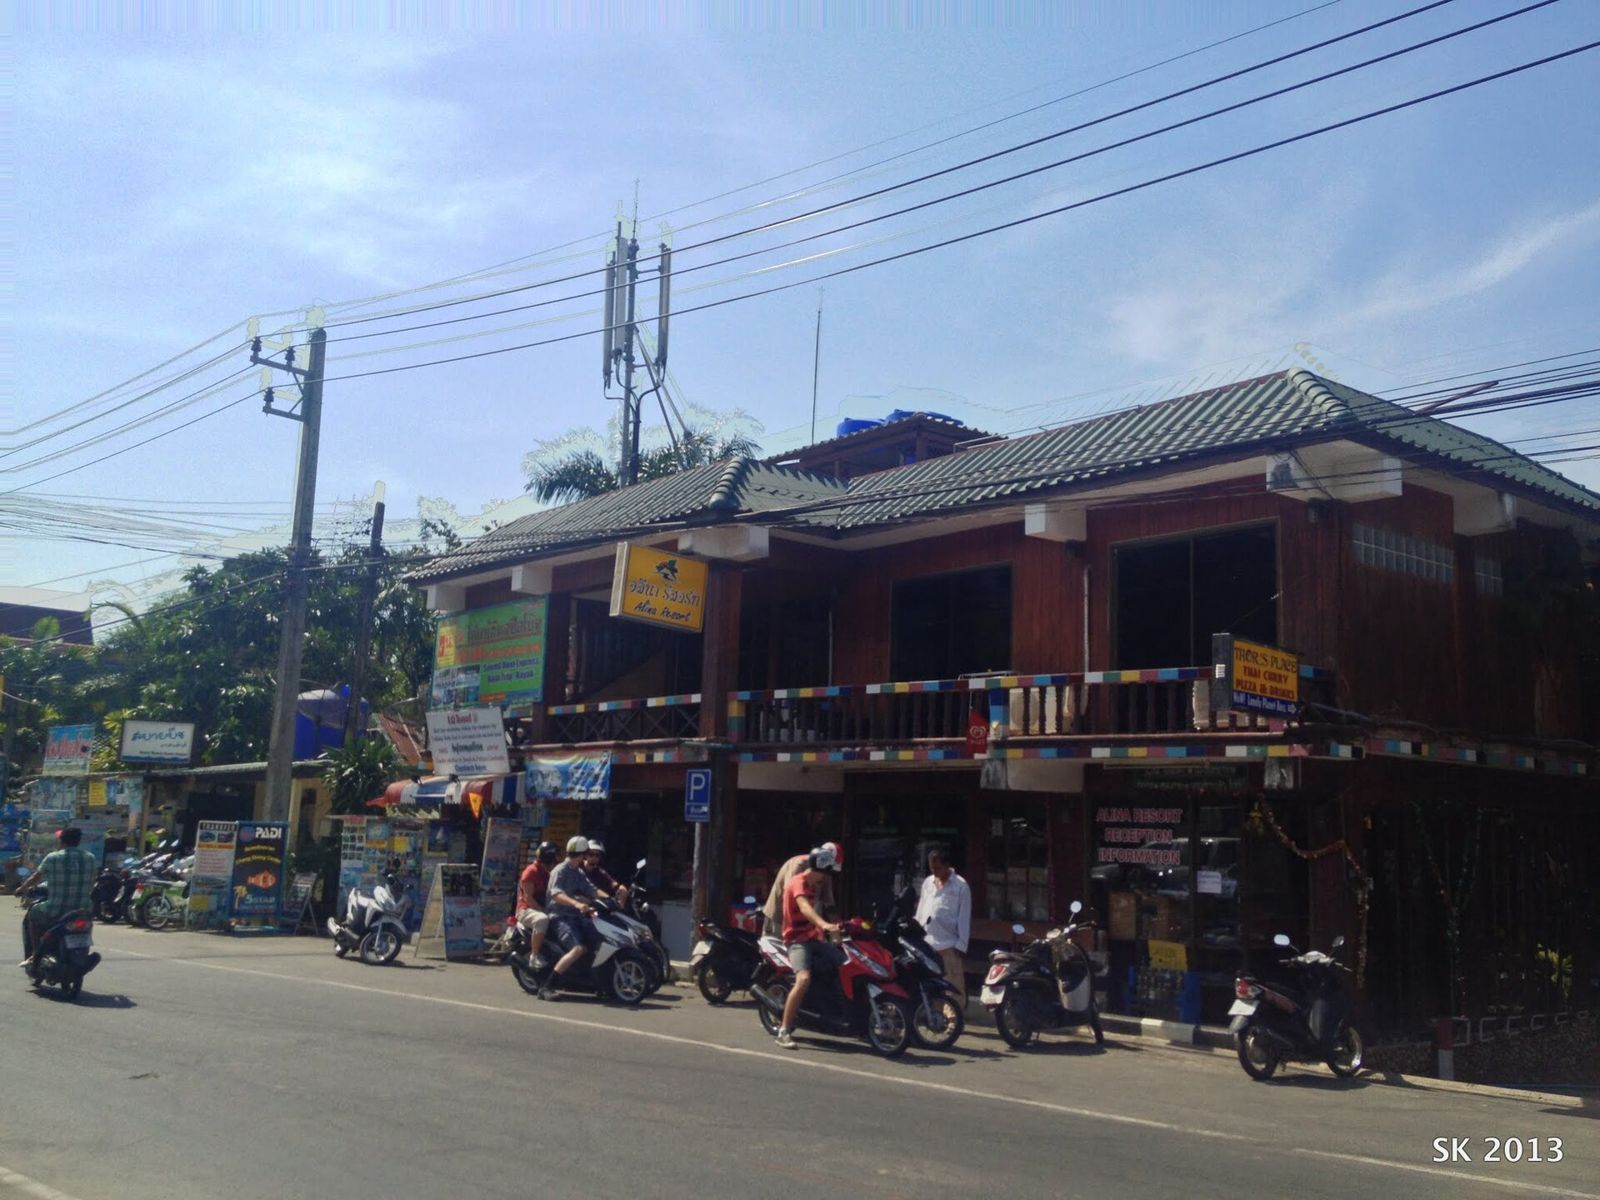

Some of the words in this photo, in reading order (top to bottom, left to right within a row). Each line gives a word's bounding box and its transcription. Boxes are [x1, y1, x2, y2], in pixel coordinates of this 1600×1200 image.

[1235, 678, 1257, 692] PIZZA
[691, 773, 706, 800] P
[1097, 808, 1131, 823] ALINA
[1132, 808, 1184, 823] RESORT
[255, 826, 283, 839] PADI
[1104, 827, 1173, 844] RECEPTION
[1098, 847, 1180, 865] INFORMATION
